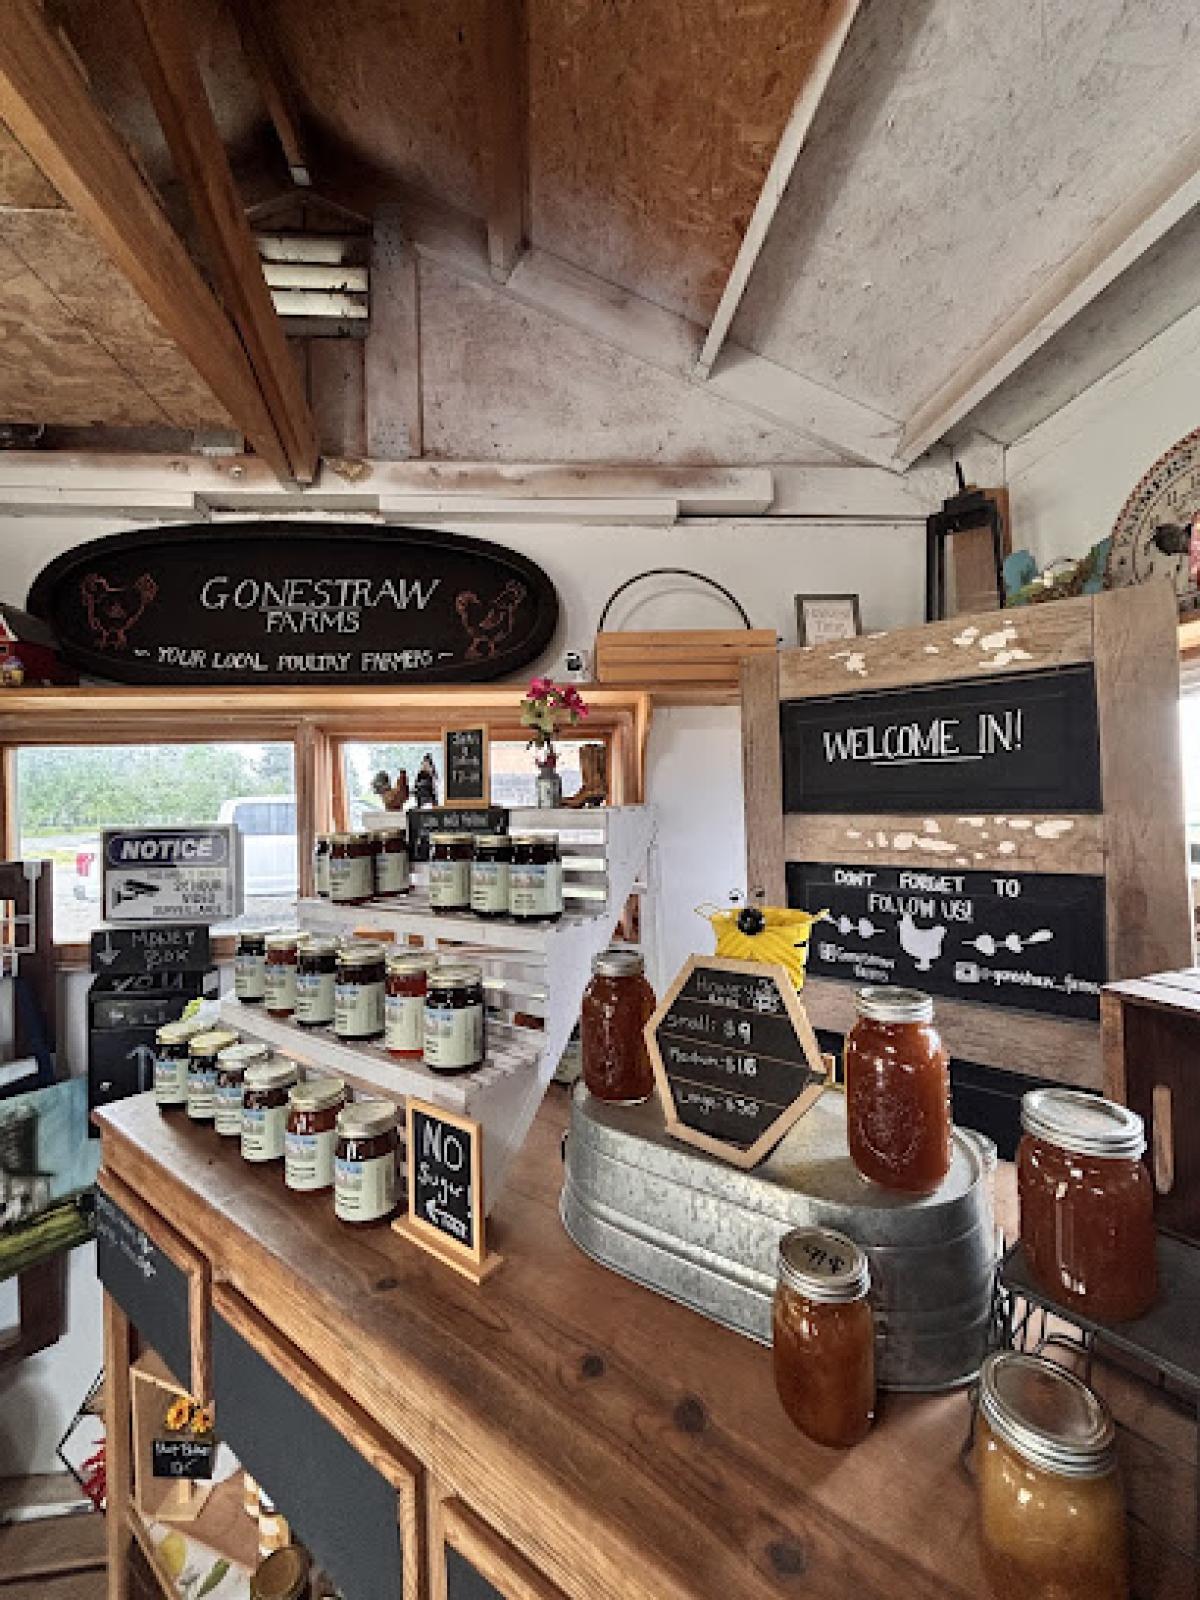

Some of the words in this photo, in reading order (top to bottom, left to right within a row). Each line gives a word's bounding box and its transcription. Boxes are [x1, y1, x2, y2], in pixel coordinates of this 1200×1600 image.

[201, 576, 441, 609] GONESTRAW
[265, 611, 360, 633] FARMS
[159, 647, 206, 668] YOUR
[212, 653, 268, 671] LOCAL
[278, 653, 350, 671] POULTRY
[361, 649, 433, 671] FARMERS
[823, 719, 960, 762] WELCOME
[978, 708, 1022, 753] IN!
[121, 838, 213, 859] NOTICE
[899, 870, 966, 893] FORGET
[991, 878, 1022, 898] TO
[868, 893, 935, 918] FOLLOW
[423, 1120, 463, 1171] NO
